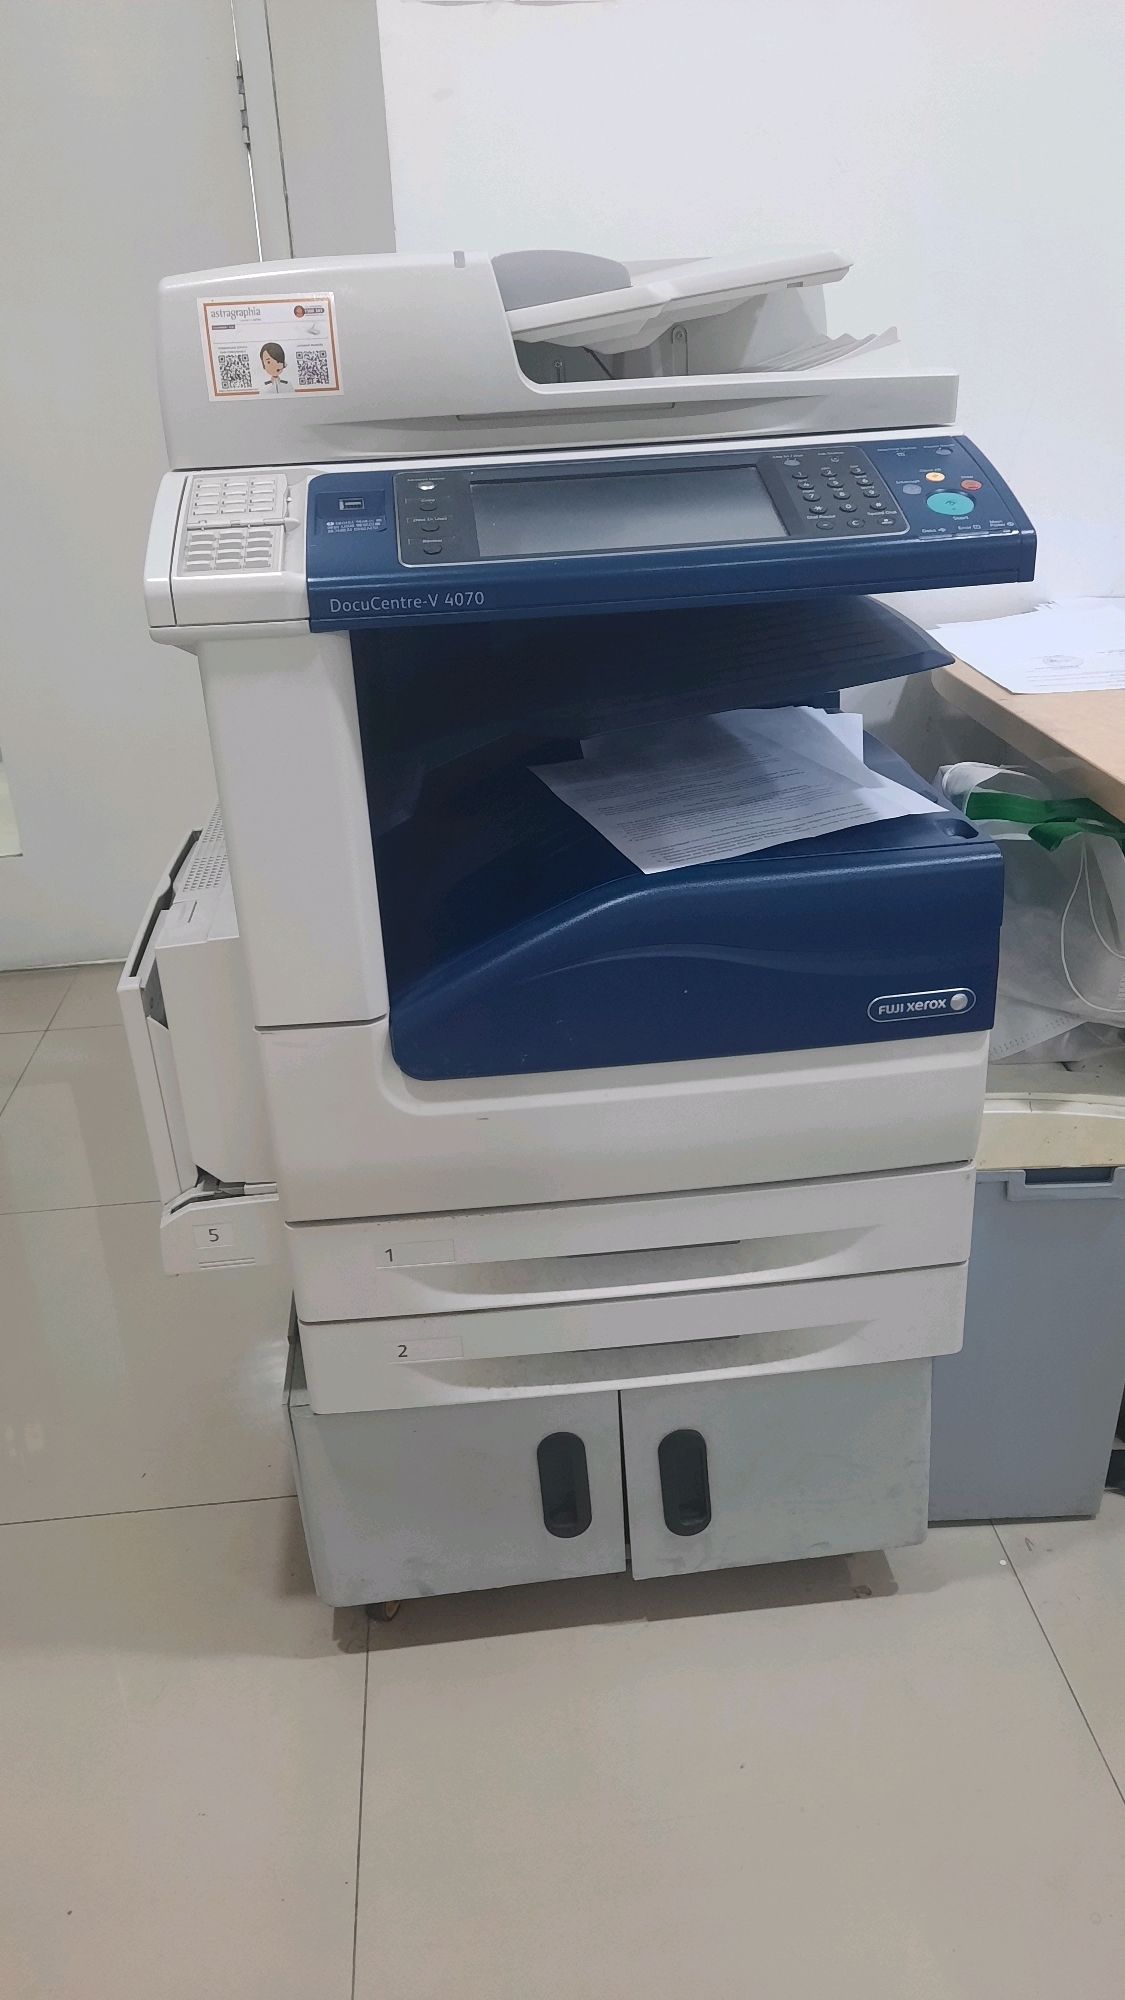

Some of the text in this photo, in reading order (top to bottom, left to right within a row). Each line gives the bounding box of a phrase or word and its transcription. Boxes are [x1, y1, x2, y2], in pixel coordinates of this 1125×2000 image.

[211, 307, 261, 320] astragraphia
[330, 591, 485, 612] DocuCentre-V 4070
[878, 999, 947, 1015] FUJI xerox
[209, 1228, 219, 1242] 5
[385, 1249, 393, 1262] 1
[398, 1345, 408, 1358] 2
